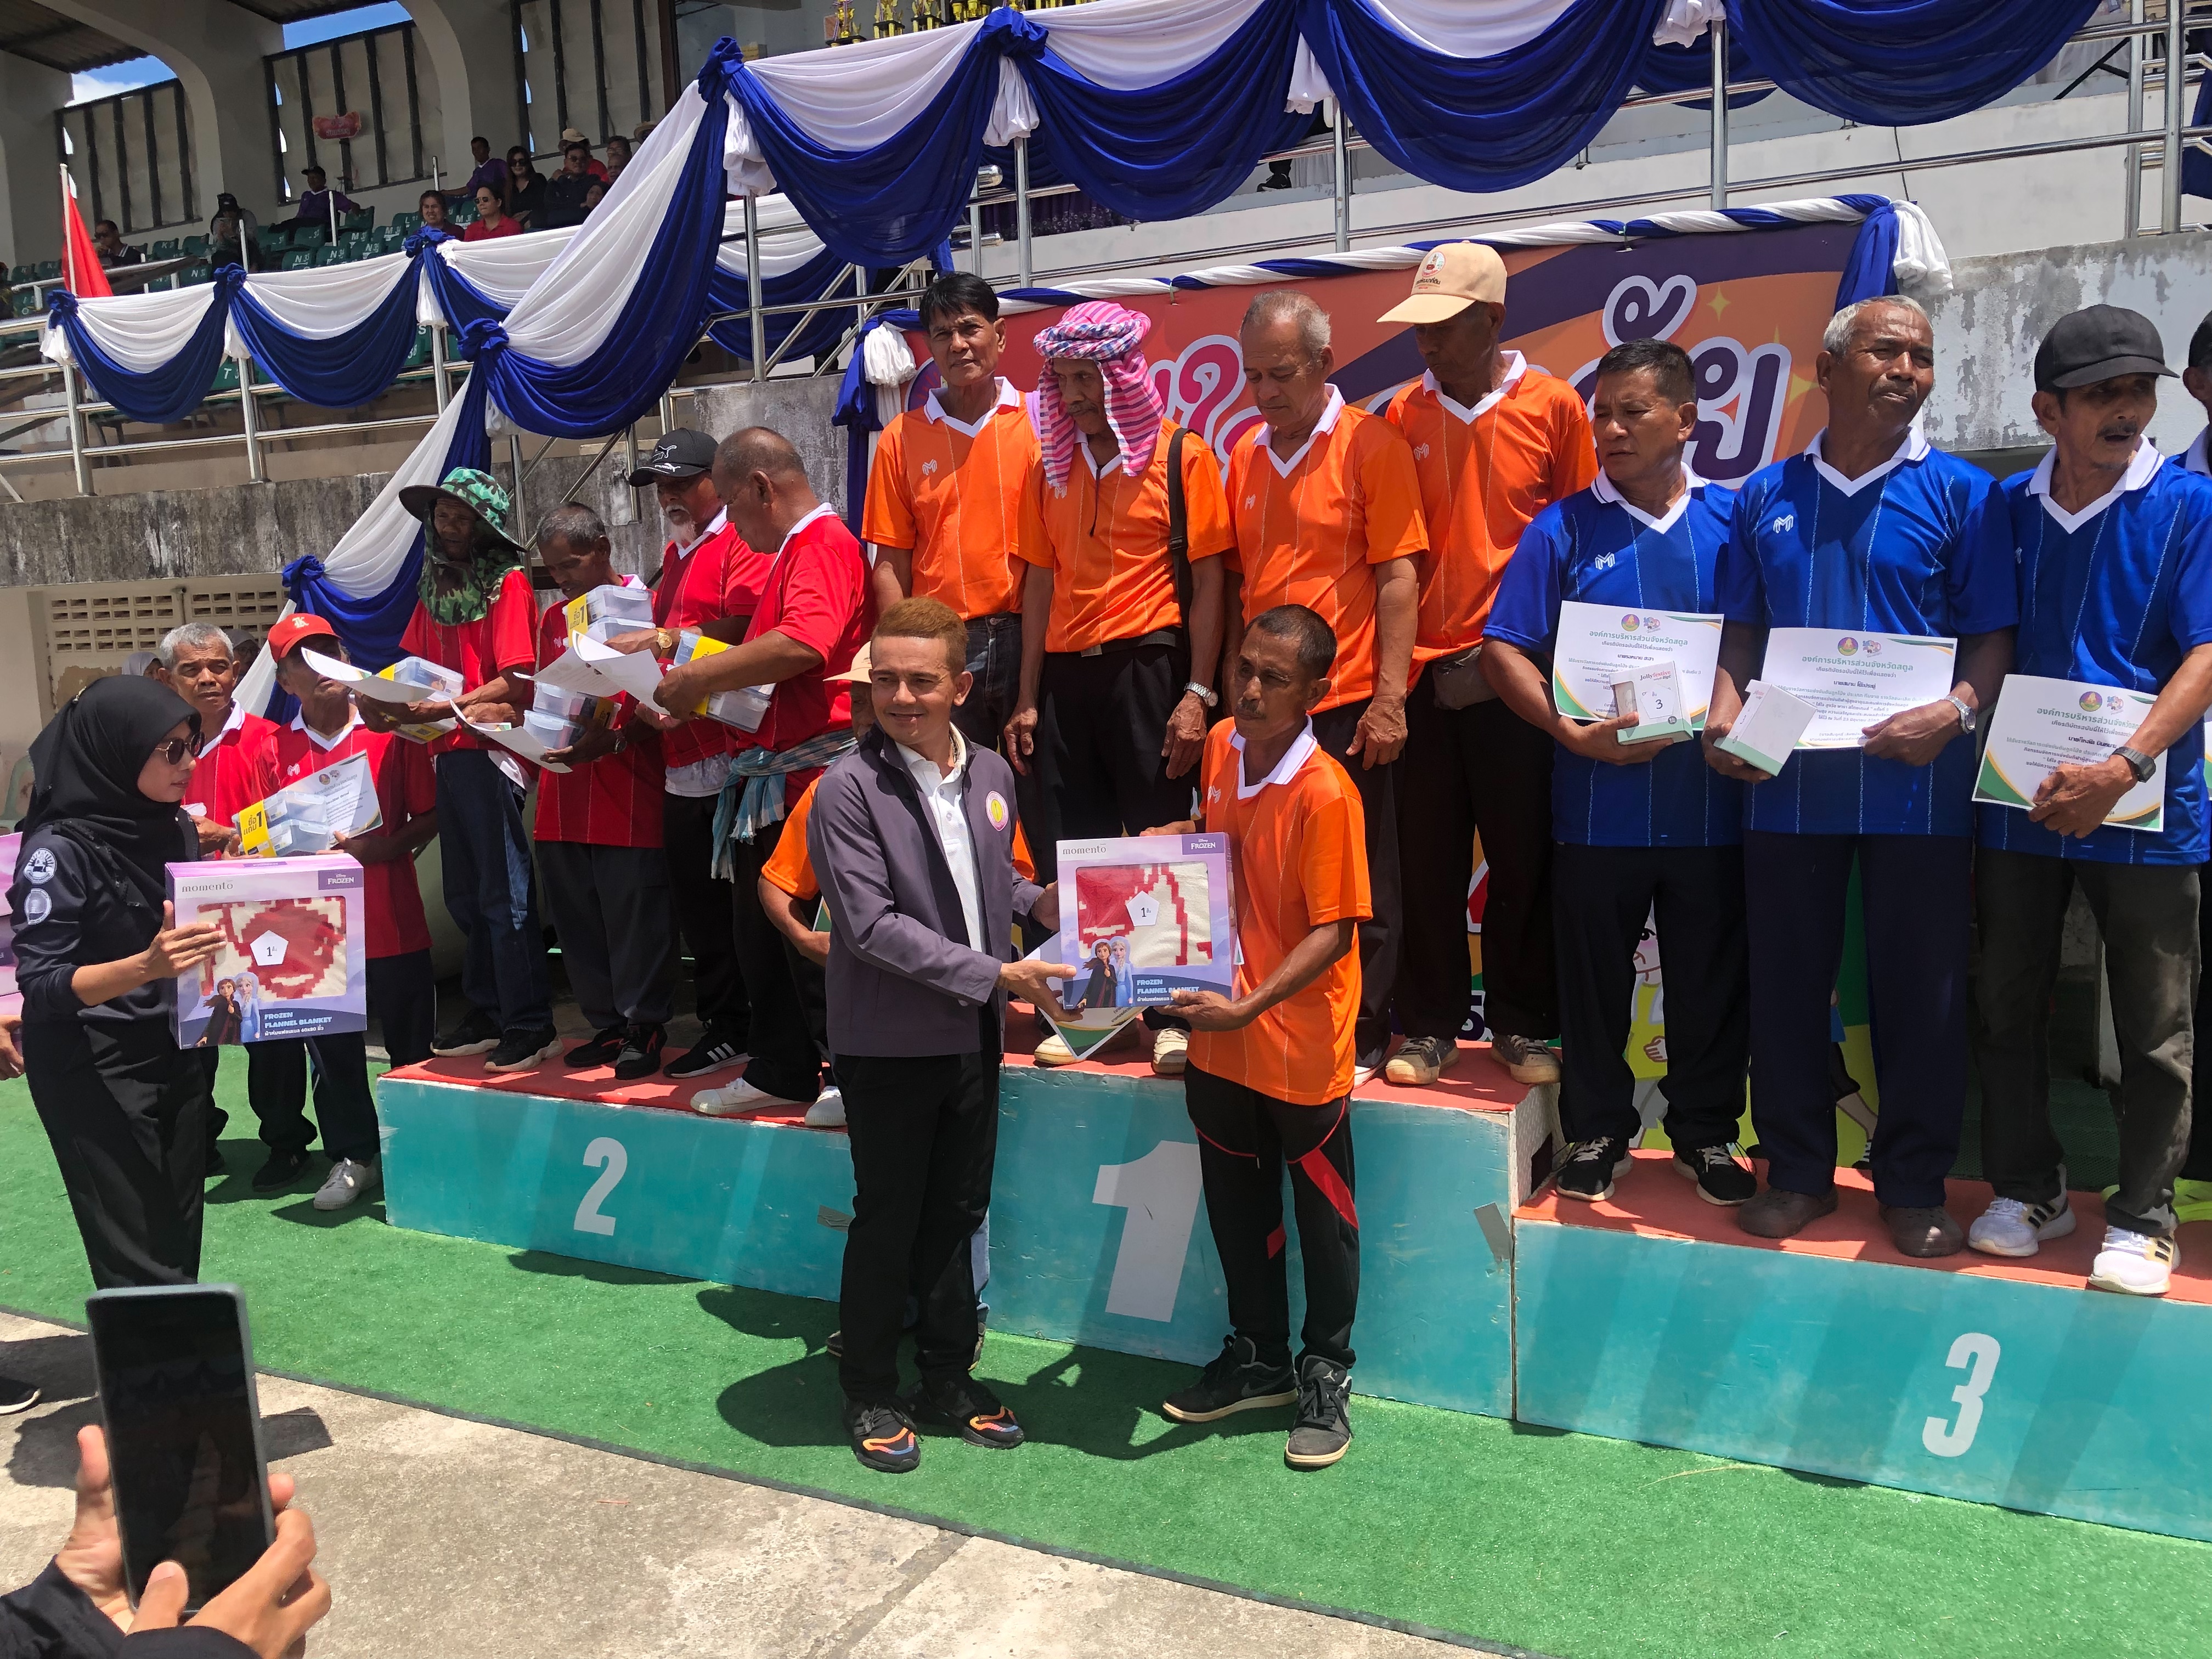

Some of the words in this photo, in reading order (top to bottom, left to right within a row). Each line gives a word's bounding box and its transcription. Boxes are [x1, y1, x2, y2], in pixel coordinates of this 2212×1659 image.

[224, 368, 232, 380] T
[1589, 630, 1689, 647] องค์การบริหารส่วนจังหวัดสตูล
[1802, 656, 1914, 672] องค์การบริหารส่วนจังหวัดสตูล
[1655, 699, 1663, 709] 3
[256, 811, 262, 827] 1
[1063, 845, 1107, 855] momento
[182, 881, 234, 893] momento
[328, 877, 355, 885] FROZEN
[1141, 907, 1147, 917] 1
[267, 946, 273, 956] 1
[264, 1012, 294, 1020] FROZEN
[264, 1020, 298, 1029] FLANNEL
[298, 1017, 332, 1025] BLANKET
[574, 1137, 628, 1236] 2
[1092, 1139, 1203, 1323] 1
[1922, 1332, 2001, 1458] 3
